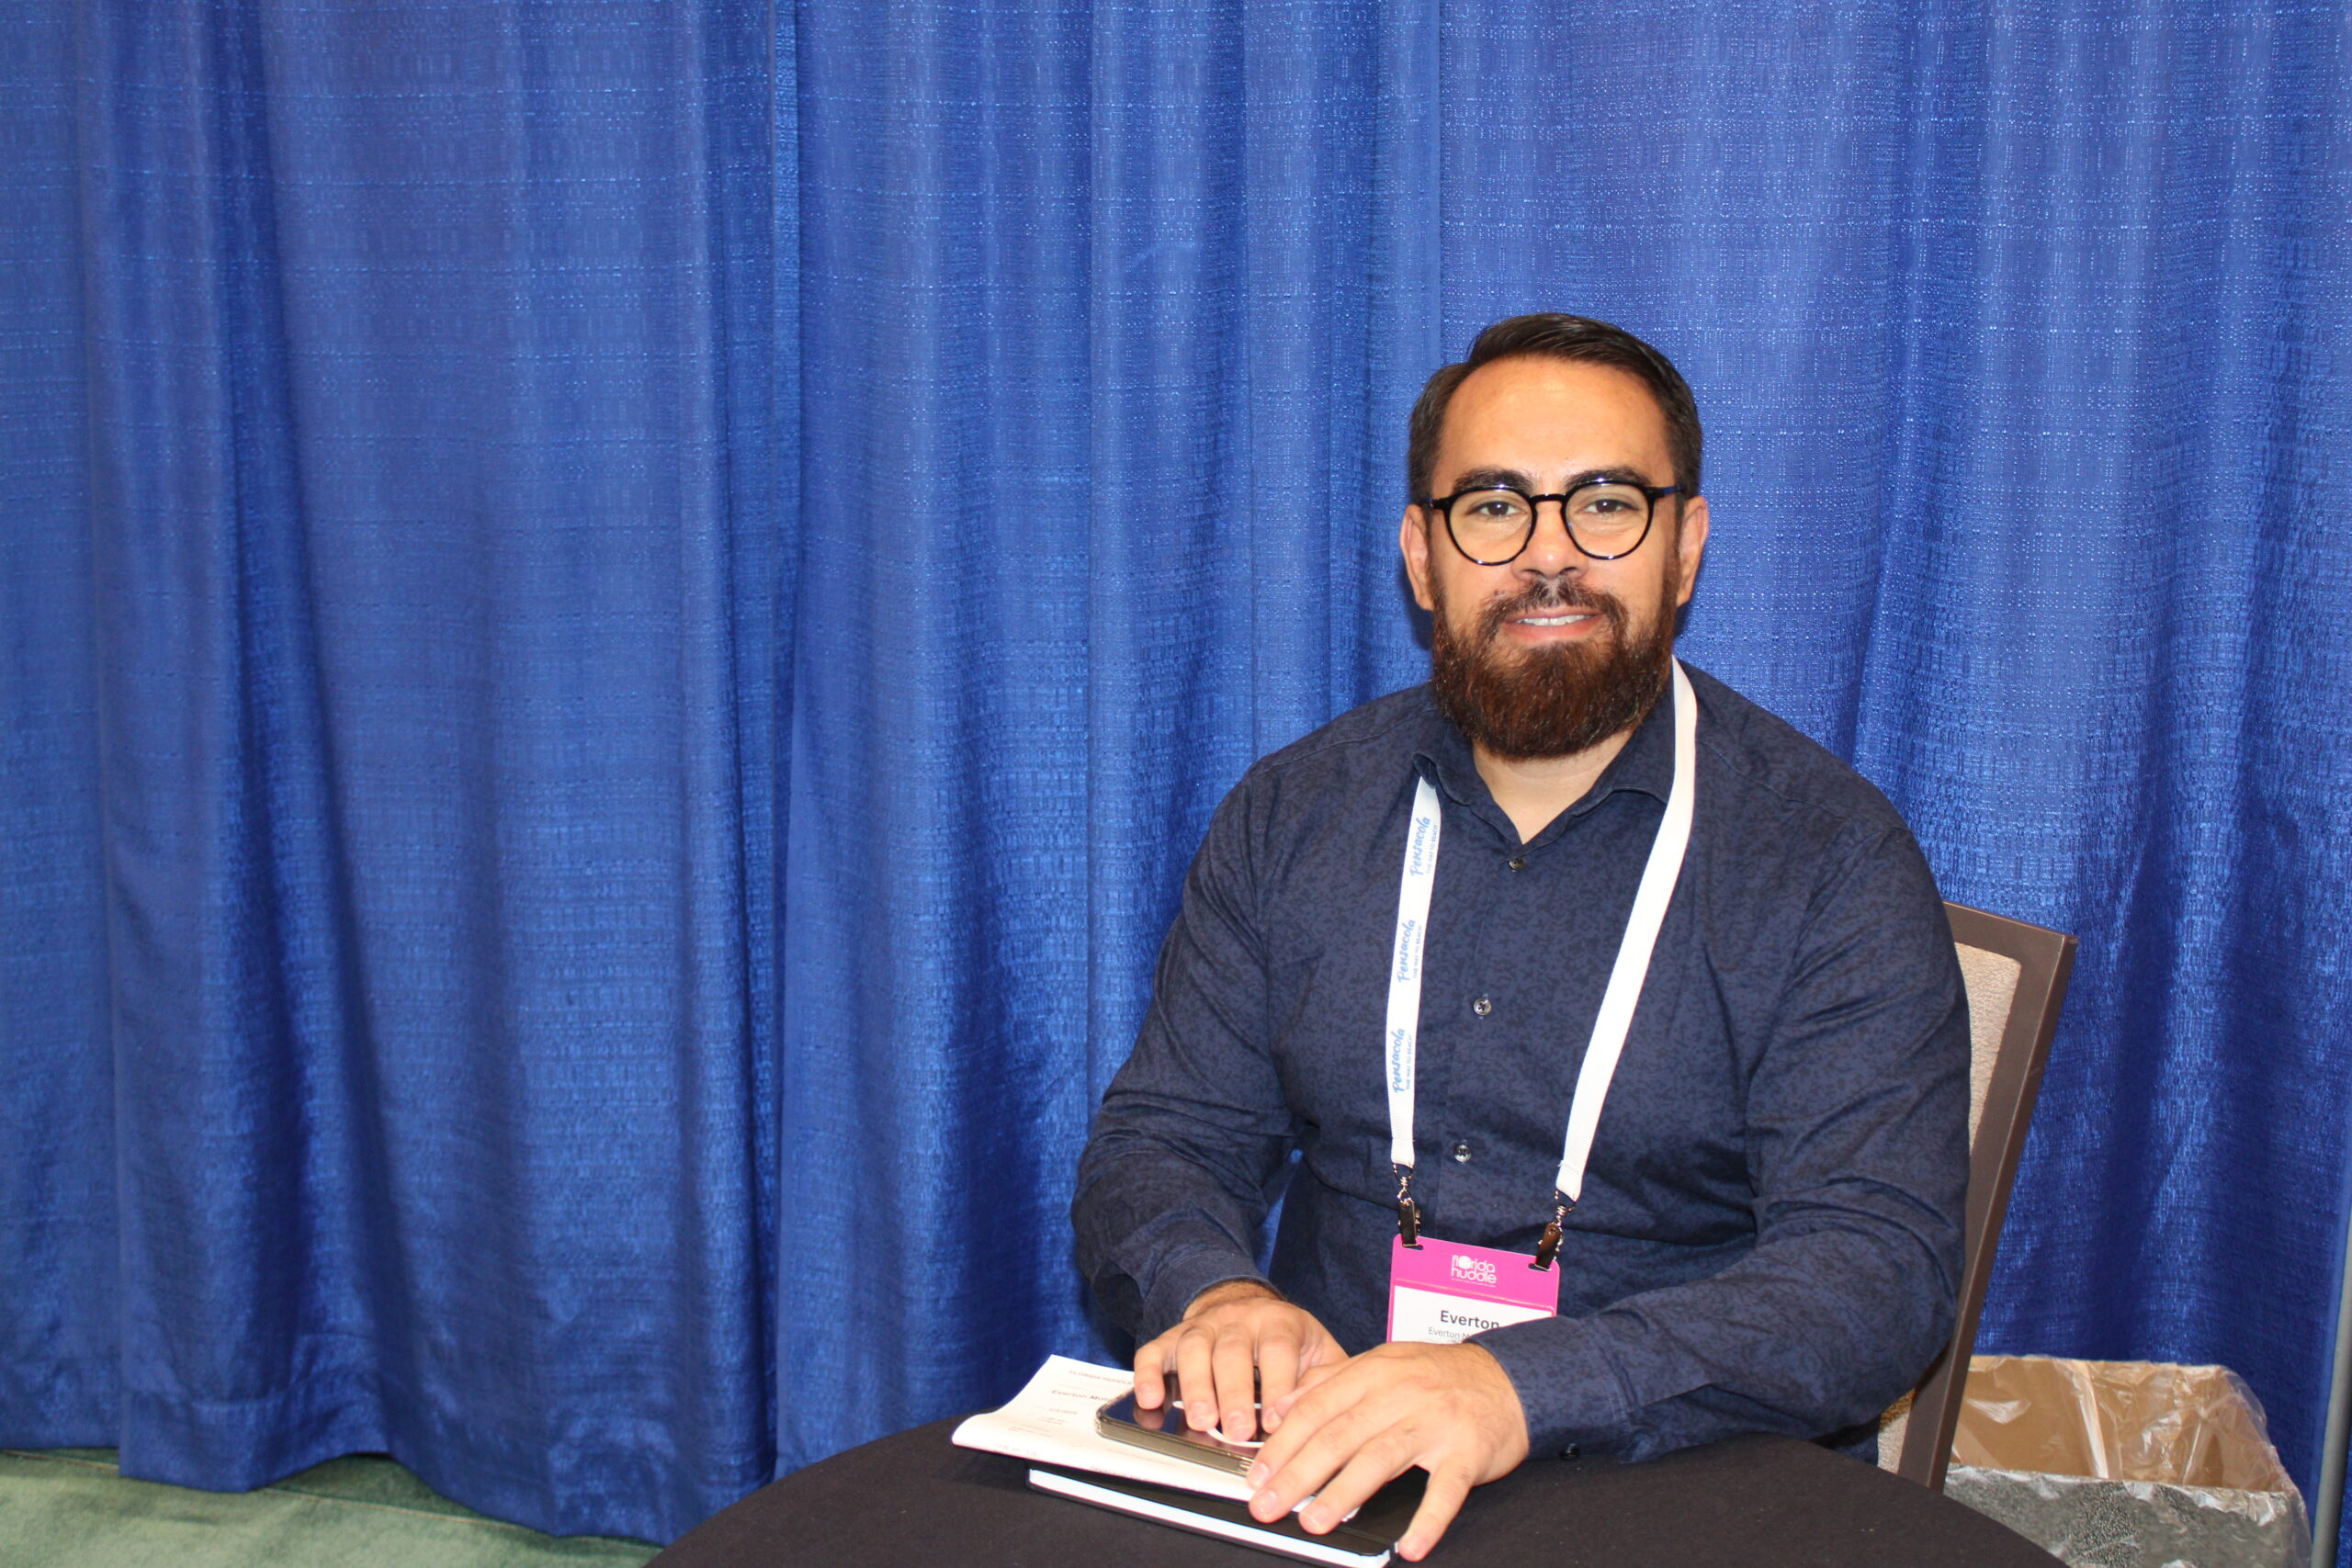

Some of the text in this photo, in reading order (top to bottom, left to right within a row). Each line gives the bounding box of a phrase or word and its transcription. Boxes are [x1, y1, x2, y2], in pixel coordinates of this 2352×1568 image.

[1410, 817, 1430, 876] Pensacola
[1396, 919, 1416, 983] Pensacola
[1390, 1028, 1405, 1092] Pensacola
[1429, 1326, 1460, 1339] Everton
[1441, 1310, 1499, 1329] Everton
